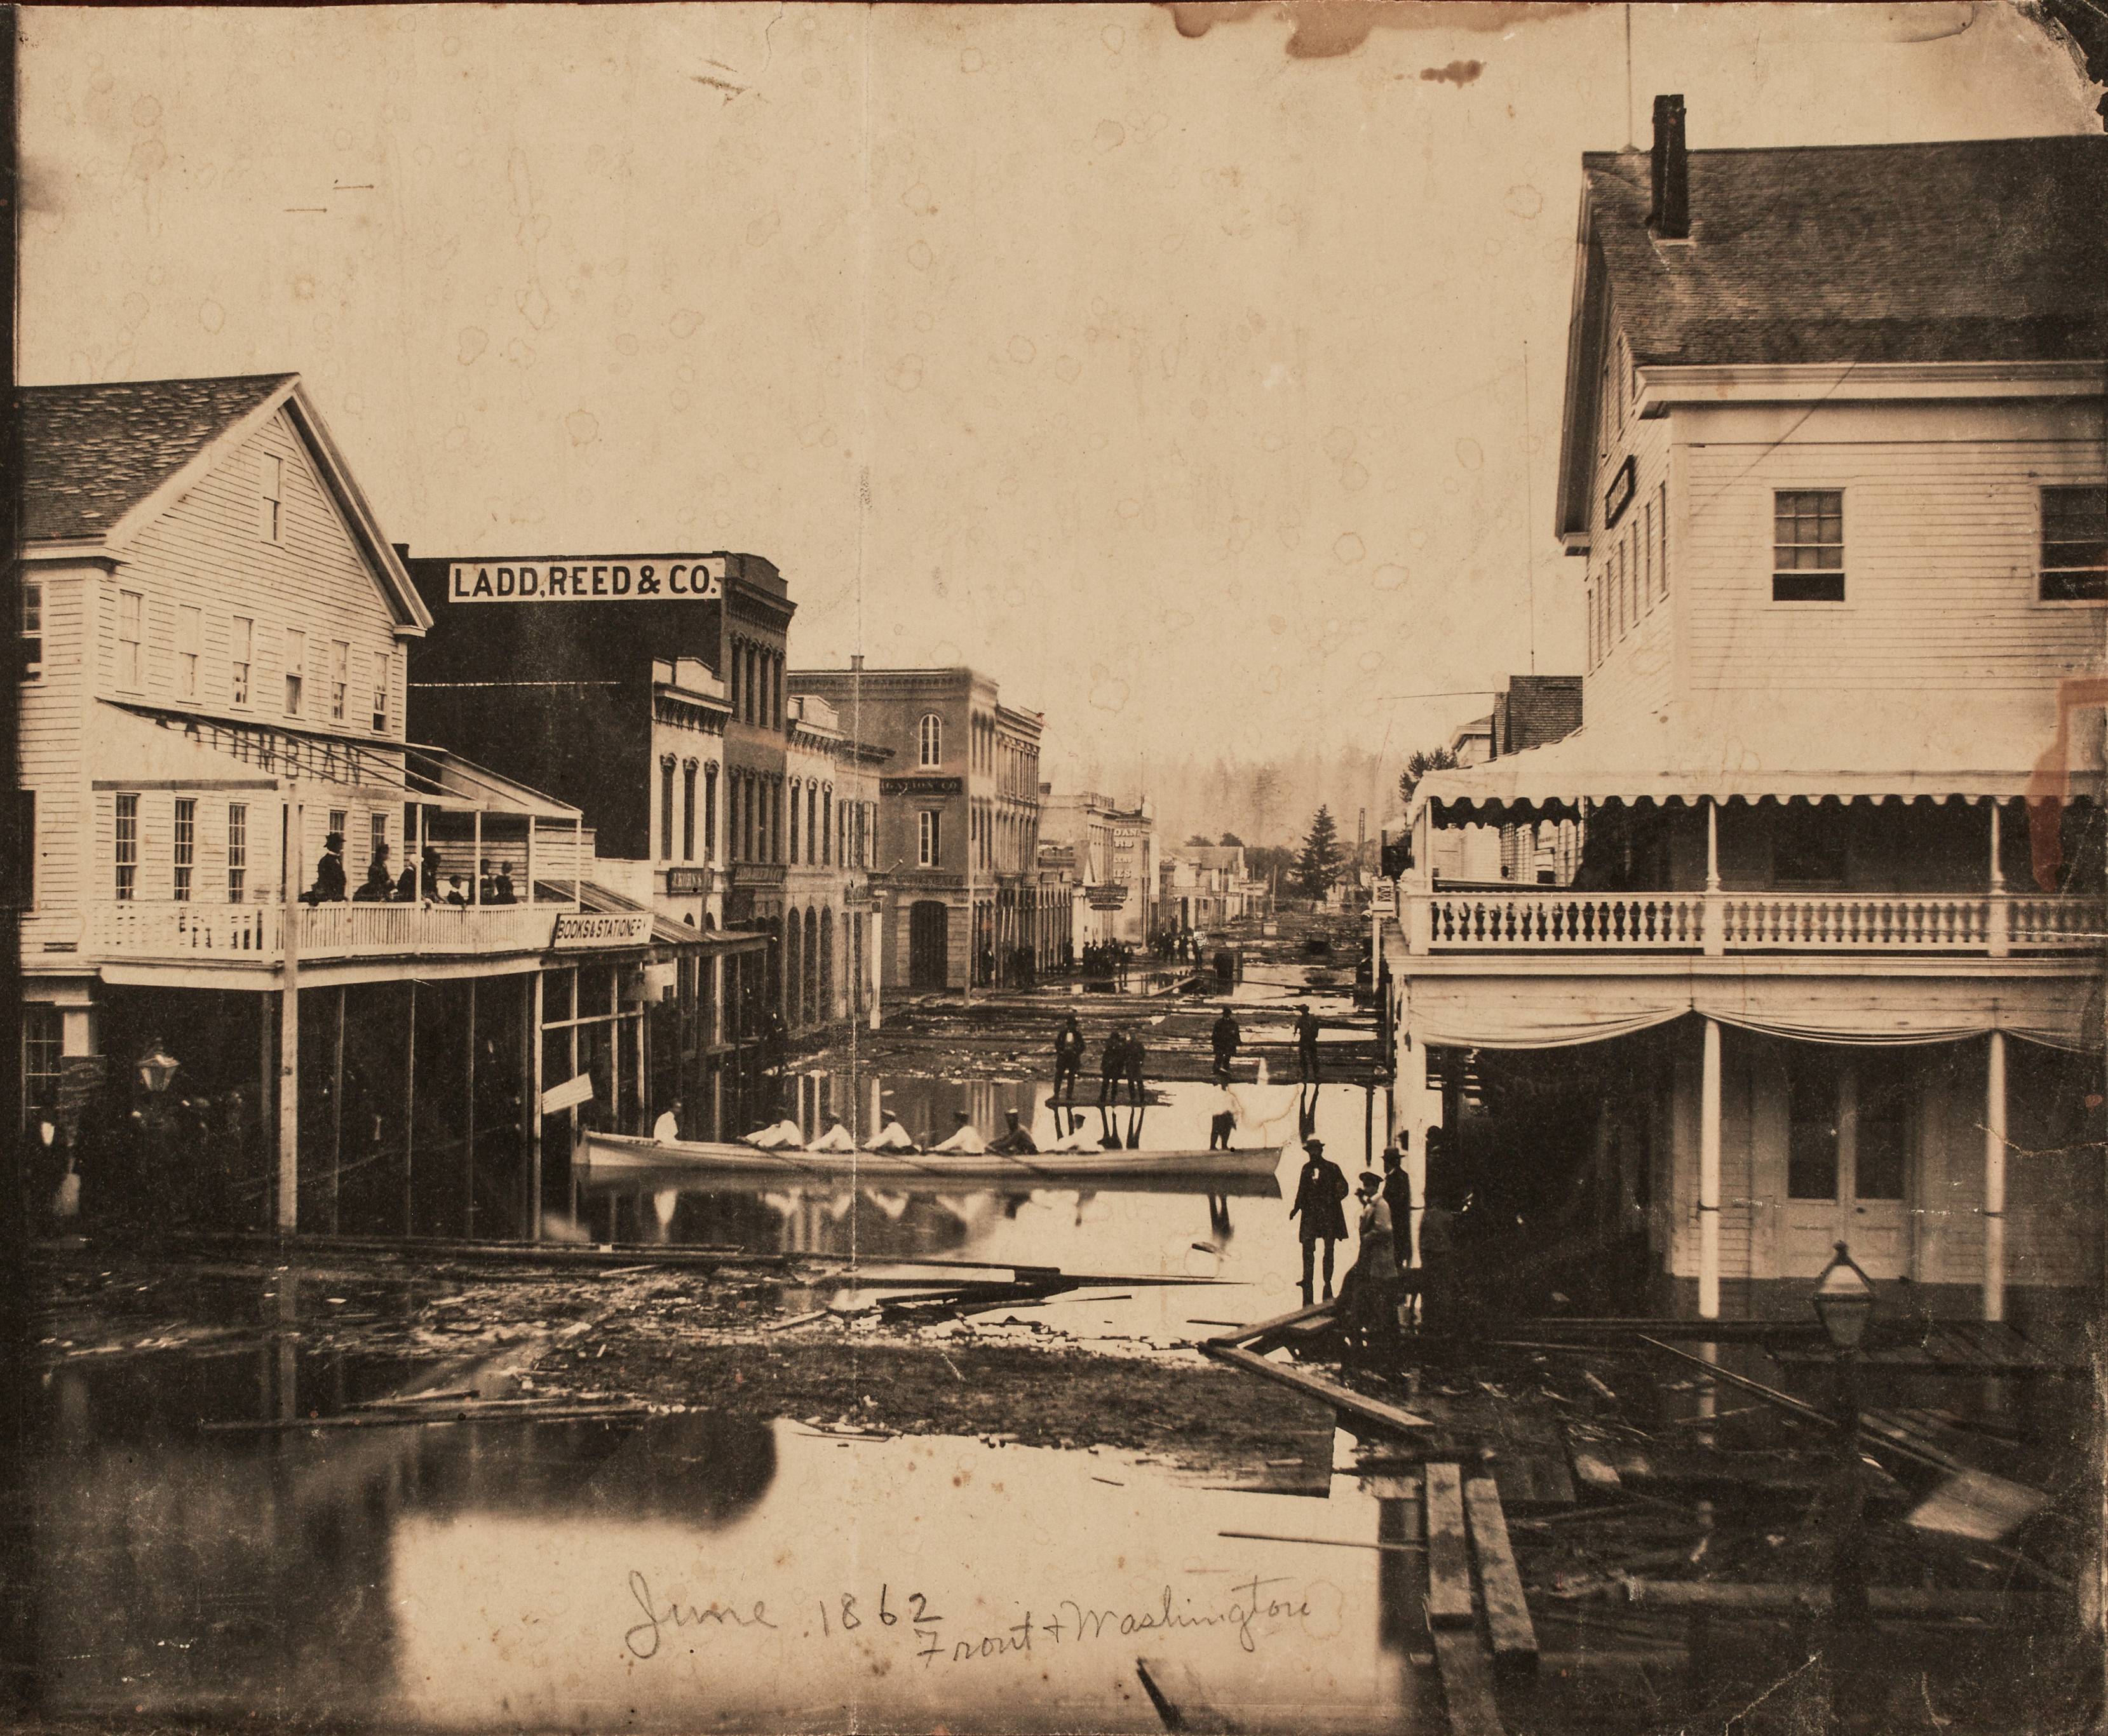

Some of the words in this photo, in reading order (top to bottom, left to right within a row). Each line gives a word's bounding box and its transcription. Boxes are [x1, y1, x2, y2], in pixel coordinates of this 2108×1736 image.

[637, 565, 661, 595] &
[670, 564, 717, 595] CO.
[557, 919, 591, 939] BOOKS
[590, 921, 596, 938] &
